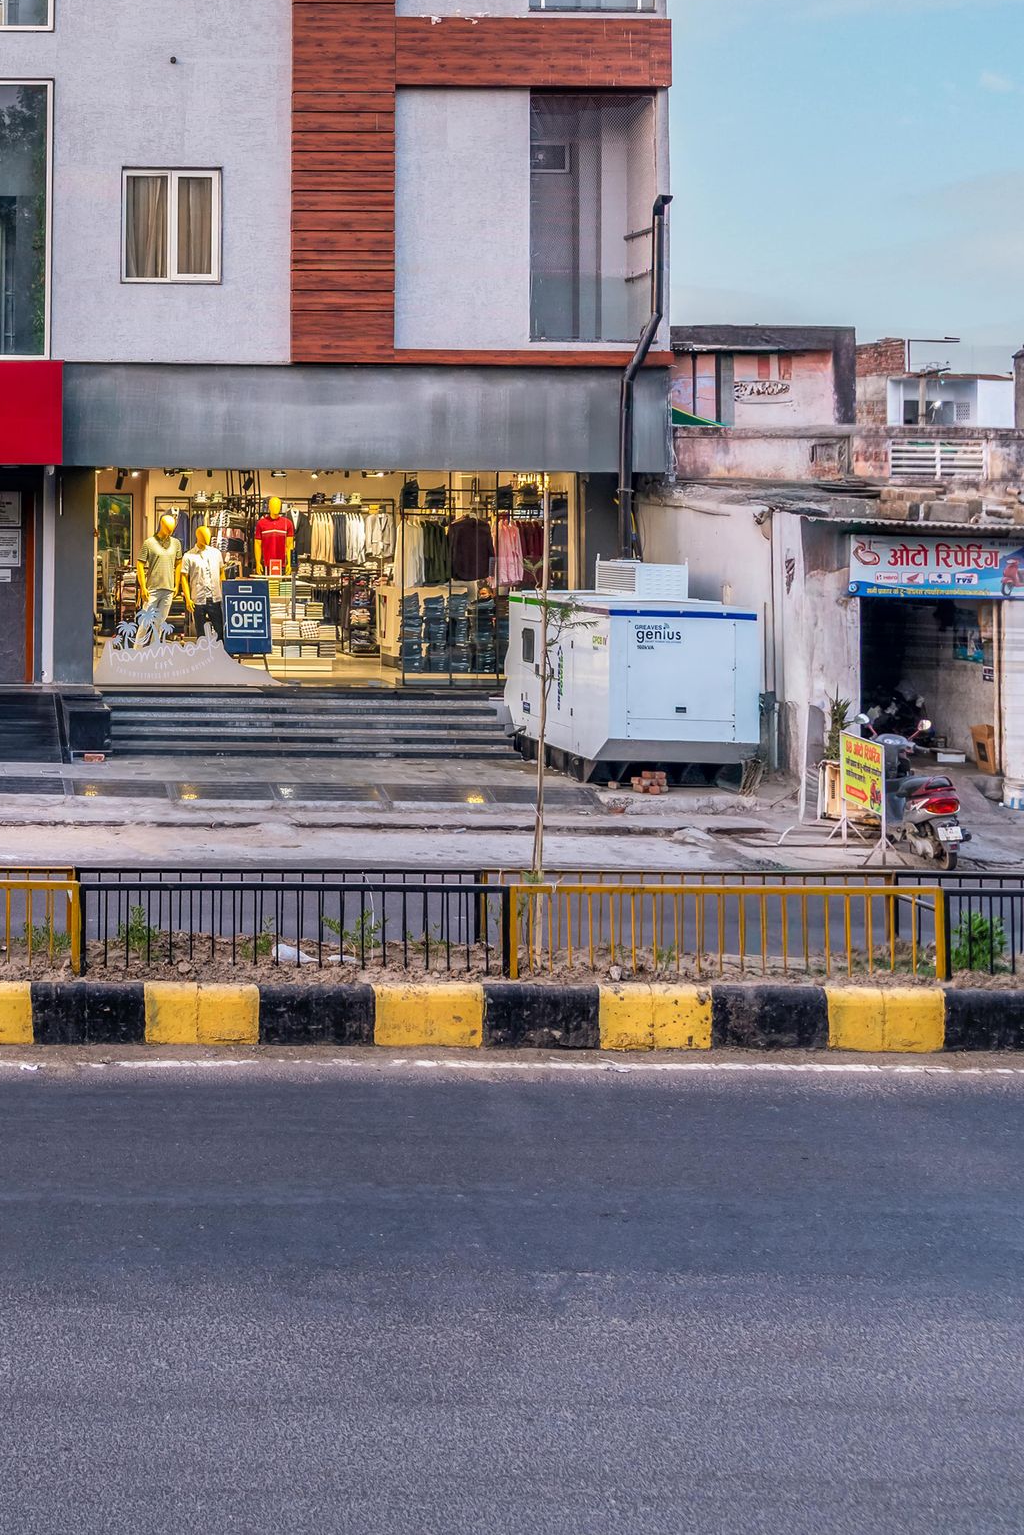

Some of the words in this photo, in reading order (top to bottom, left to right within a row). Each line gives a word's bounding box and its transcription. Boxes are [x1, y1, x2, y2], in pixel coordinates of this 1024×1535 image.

[888, 544, 930, 567] ओटो
[935, 543, 1000, 569] रिपेरिंग
[231, 613, 263, 628] OFF
[109, 623, 223, 666] hammock
[636, 626, 682, 643] genius
